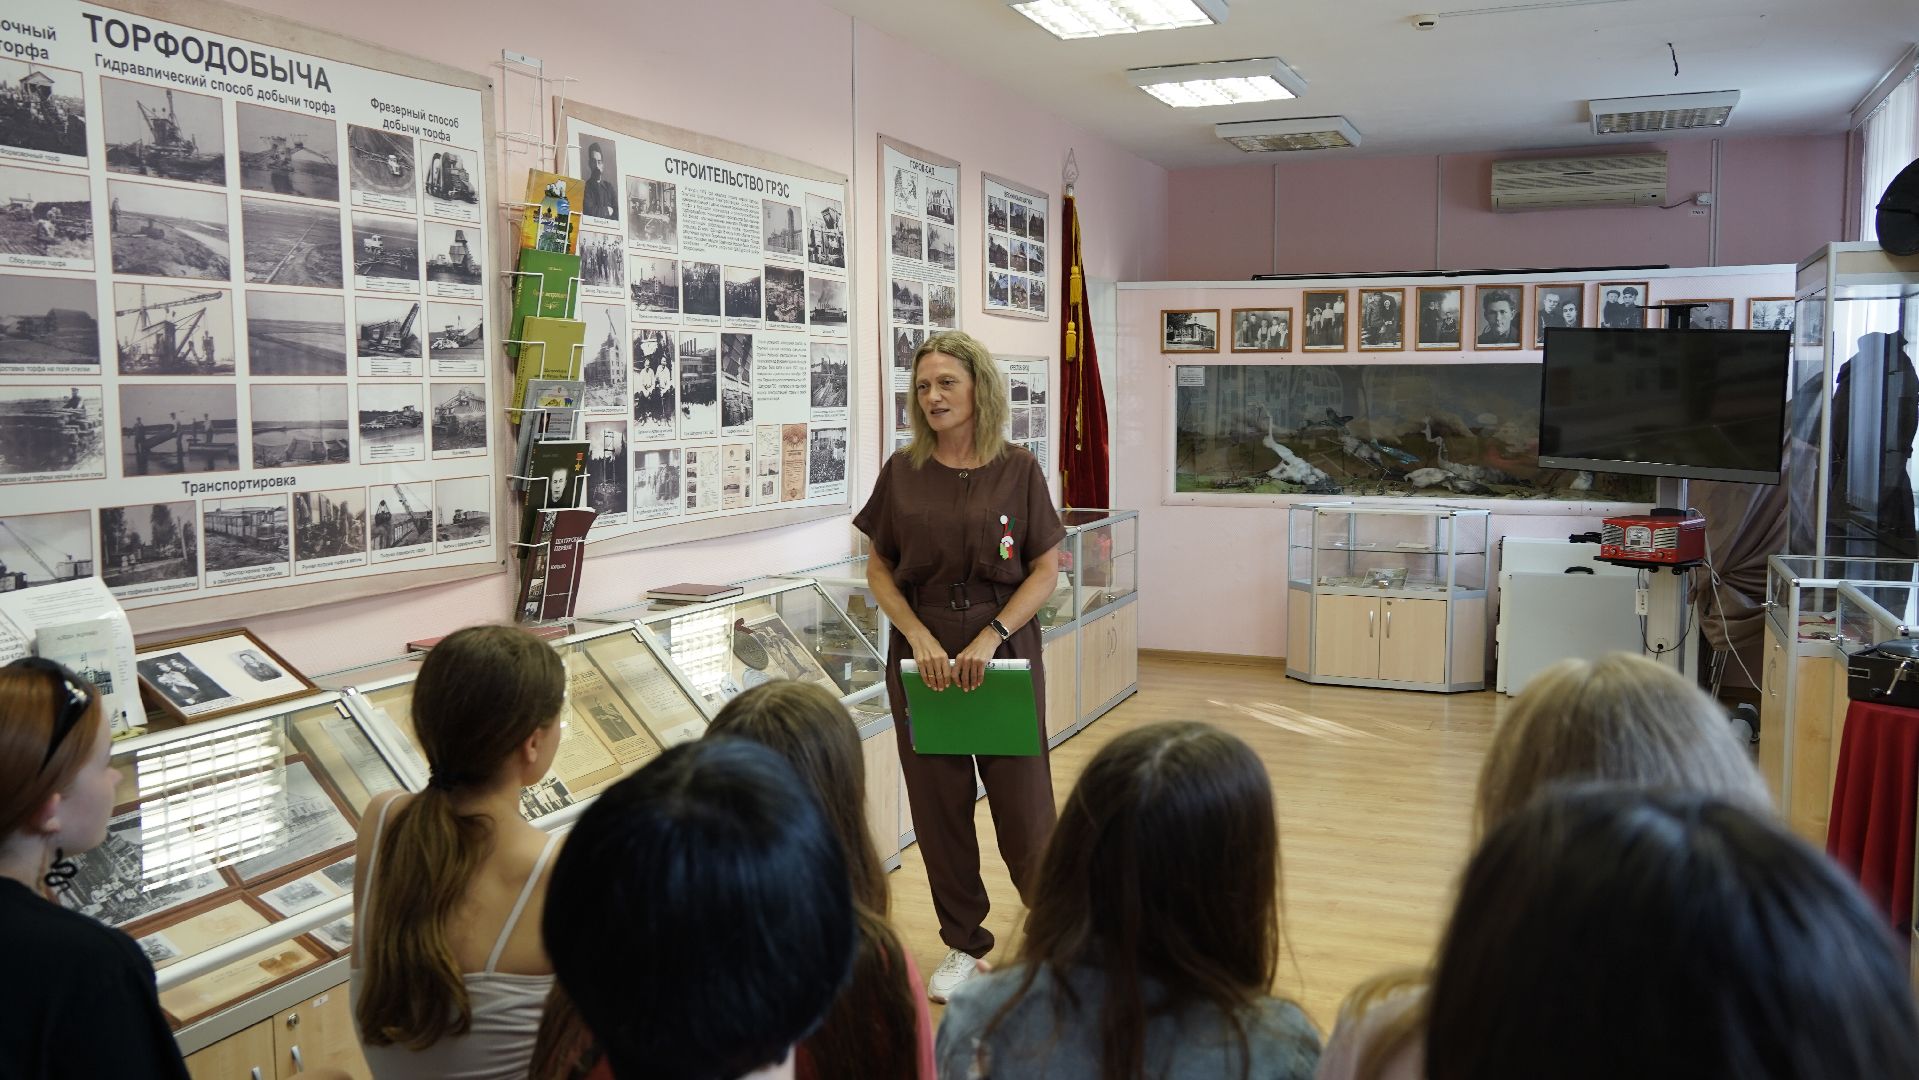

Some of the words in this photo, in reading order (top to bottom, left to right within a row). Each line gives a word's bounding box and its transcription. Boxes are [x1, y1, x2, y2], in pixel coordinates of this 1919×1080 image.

[0, 19, 57, 41] очный
[0, 40, 49, 60] орфа
[82, 12, 332, 93] ТОРФОДОБЫЧА
[94, 53, 207, 88] Гидравлический
[210, 79, 254, 97] способ
[257, 89, 301, 107] добычи
[303, 98, 336, 115] торфа
[370, 97, 426, 120] Фрезерный
[428, 113, 459, 129] способ
[382, 118, 420, 135] добычи
[422, 127, 451, 142] торфа
[664, 157, 763, 192] СТРОИТЕЛЬСТВО
[765, 179, 790, 199] ГРЭС
[181, 476, 297, 497] Транспортировка
